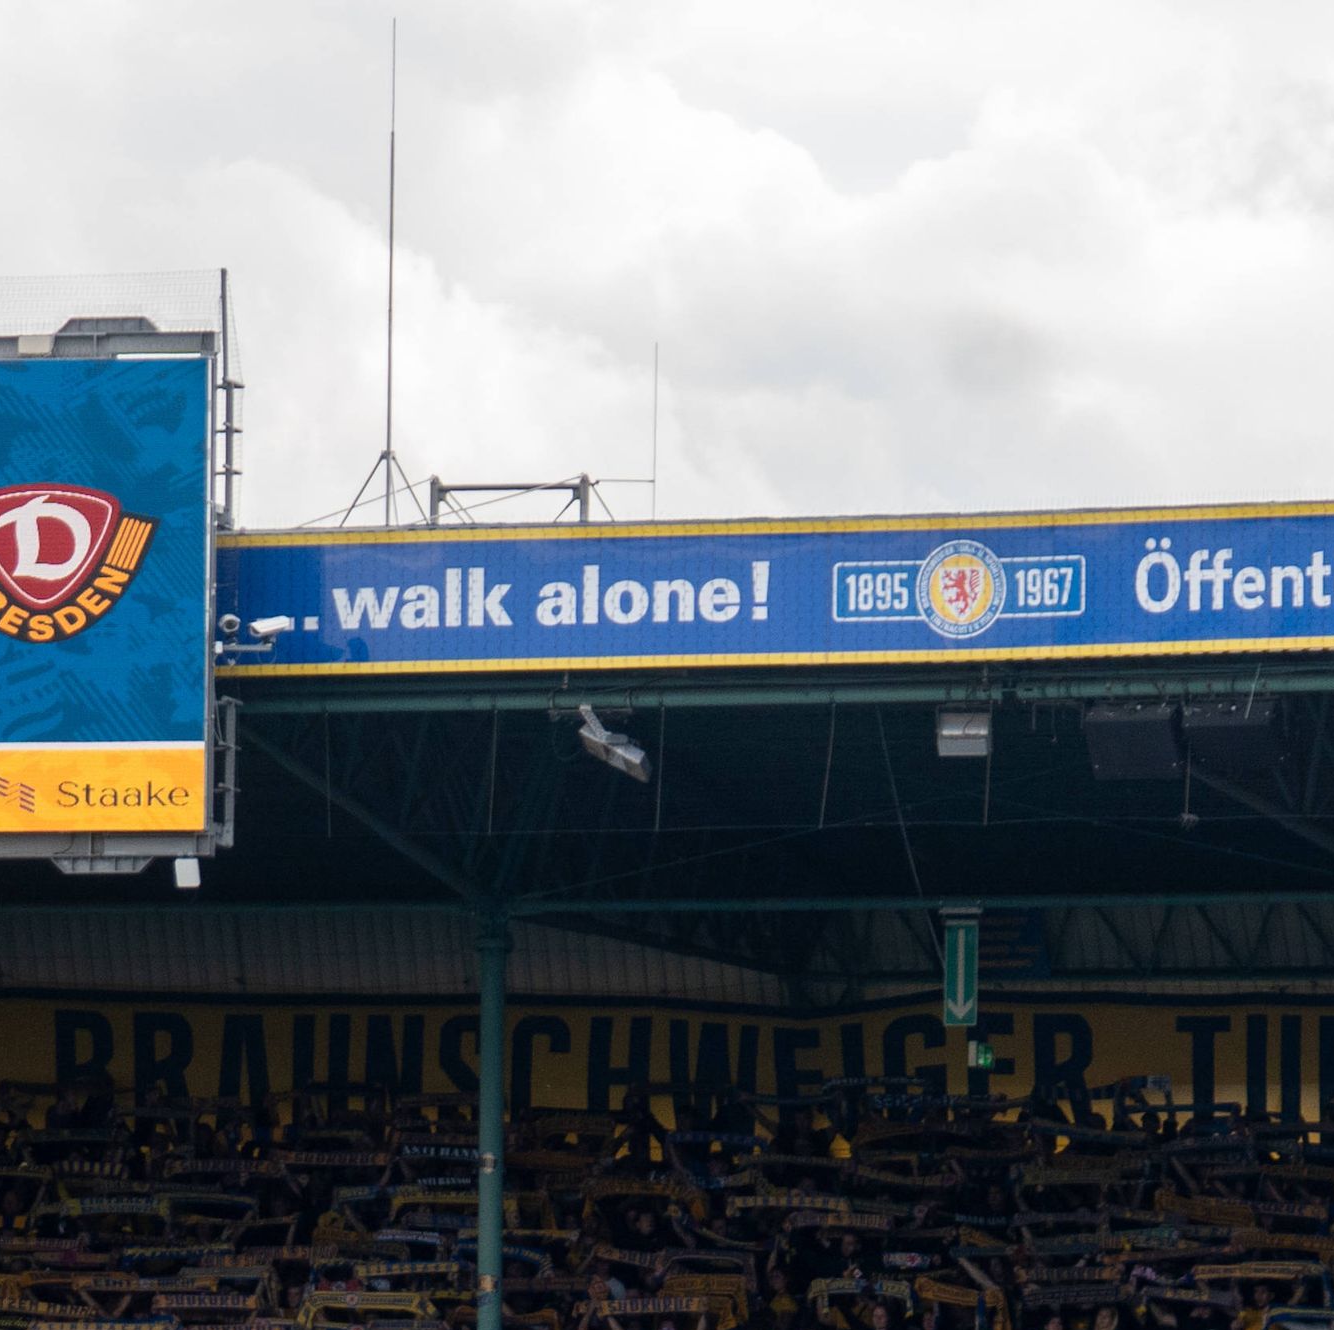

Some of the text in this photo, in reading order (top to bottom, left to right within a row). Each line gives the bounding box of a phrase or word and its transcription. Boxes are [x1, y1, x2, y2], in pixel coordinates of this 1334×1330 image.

[332, 560, 770, 631] walk alone!
[845, 573, 909, 611] 1895
[1014, 567, 1073, 607] 1967
[56, 779, 190, 808] Staake
